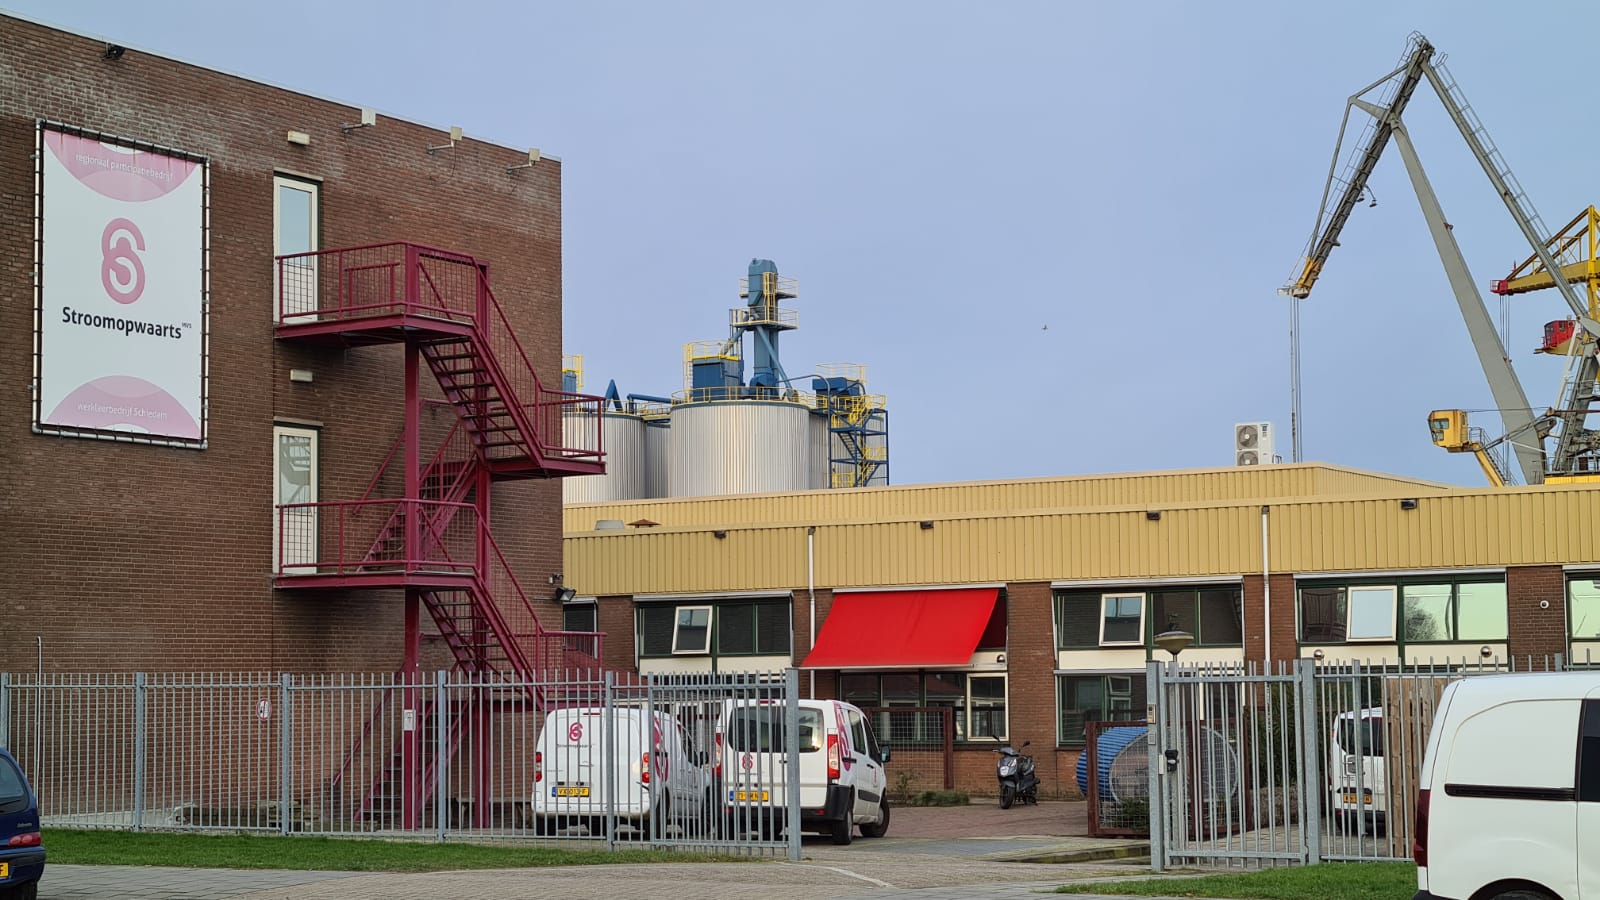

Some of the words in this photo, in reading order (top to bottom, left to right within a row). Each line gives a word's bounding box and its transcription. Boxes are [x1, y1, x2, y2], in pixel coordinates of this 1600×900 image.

[75, 154, 109, 169] regionaal
[110, 161, 173, 181] participatiebedrijf
[62, 306, 182, 339] Stroomopwaarts
[133, 407, 167, 420] Schiedam
